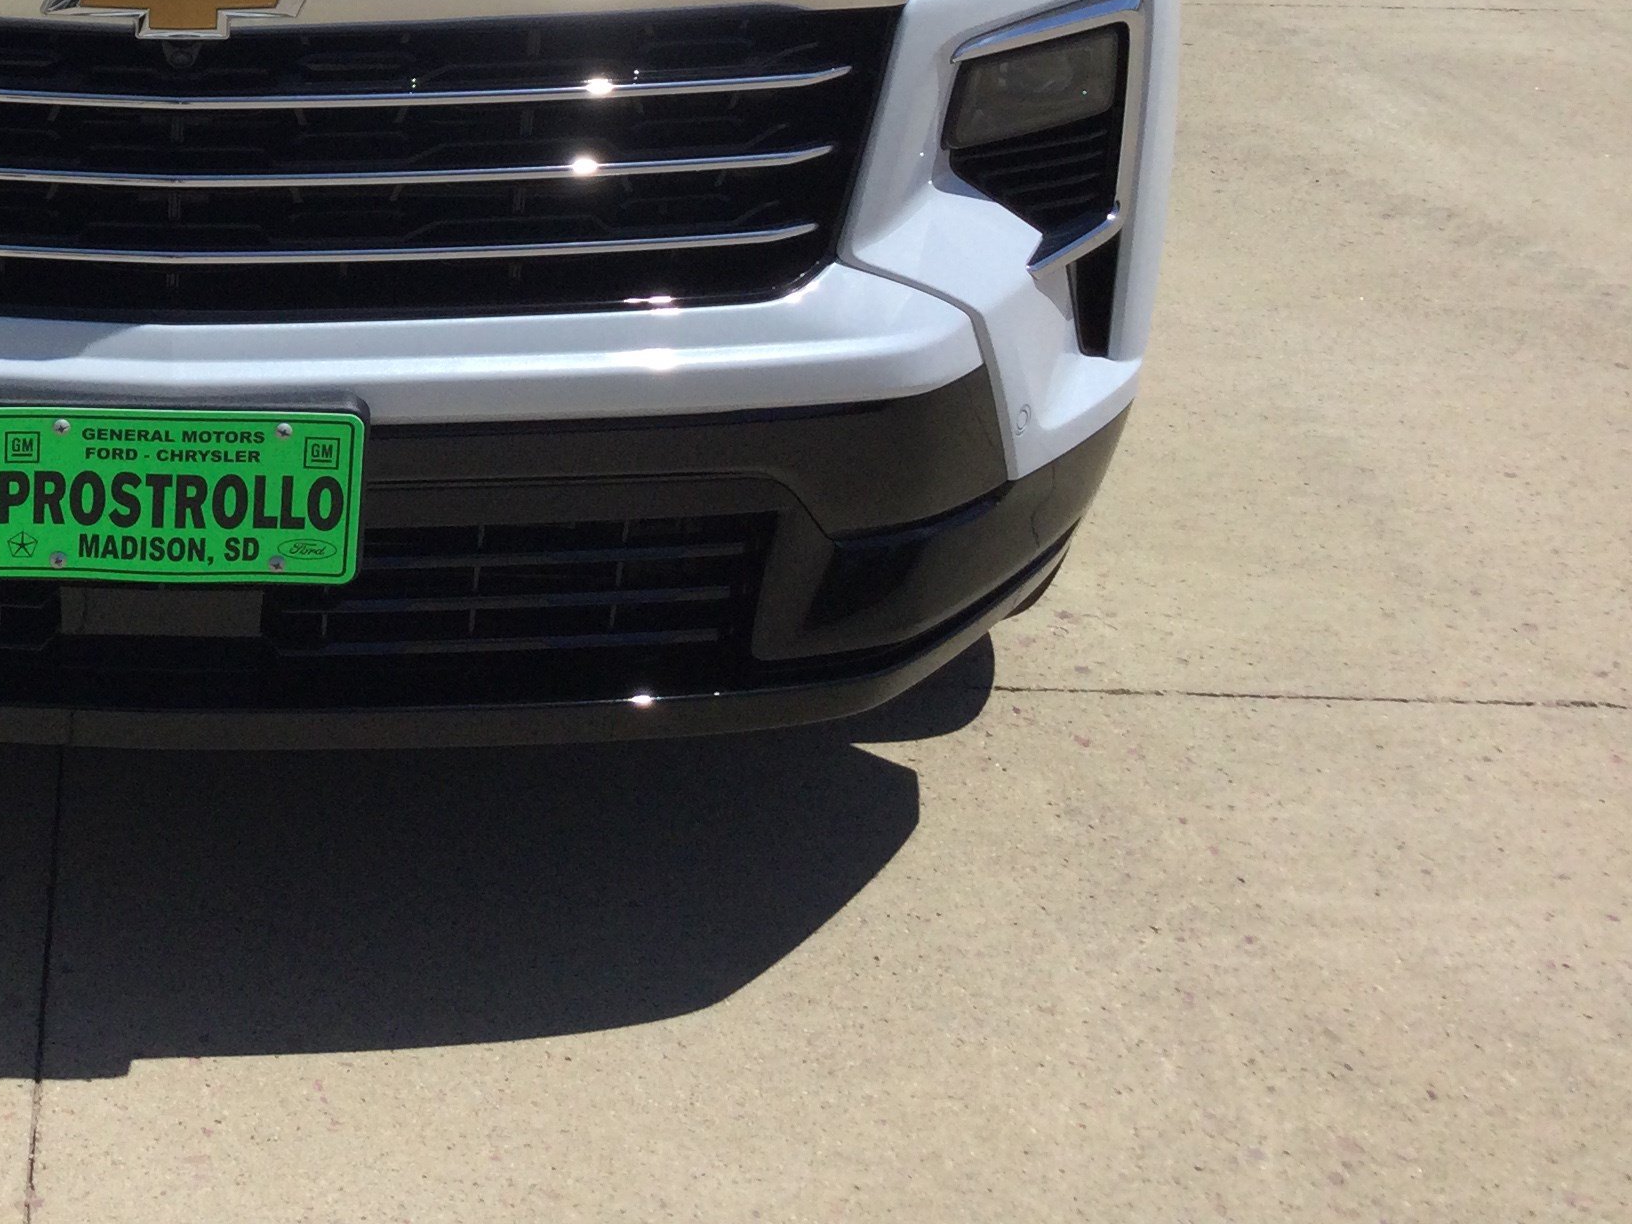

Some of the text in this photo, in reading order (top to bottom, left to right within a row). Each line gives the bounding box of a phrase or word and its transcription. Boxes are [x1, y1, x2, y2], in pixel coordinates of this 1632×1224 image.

[81, 427, 266, 445] GENERAL MOTORS
[11, 437, 34, 453] GM
[311, 443, 334, 459] GM
[85, 447, 139, 461] FORD
[156, 448, 261, 463] CHRYSLER
[78, 533, 260, 566] MADISON, SD
[289, 542, 326, 557] Ford
